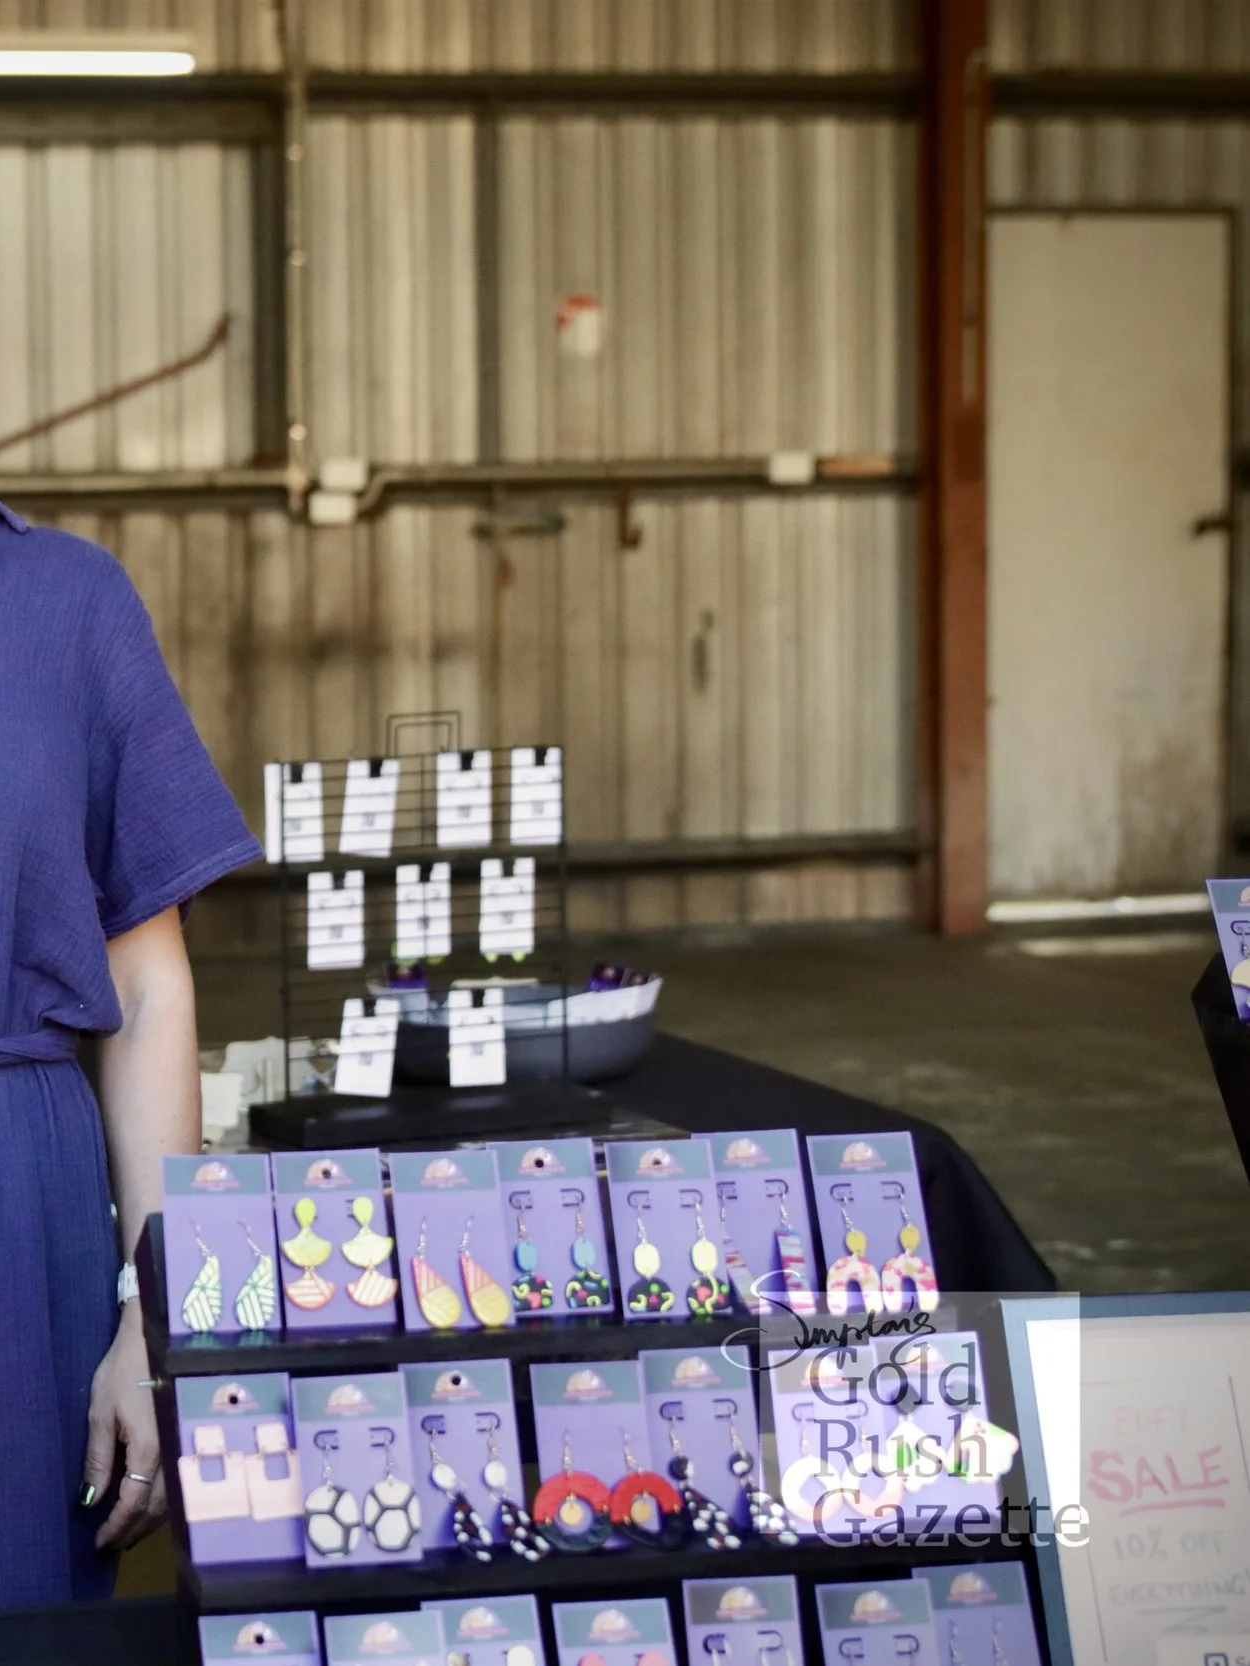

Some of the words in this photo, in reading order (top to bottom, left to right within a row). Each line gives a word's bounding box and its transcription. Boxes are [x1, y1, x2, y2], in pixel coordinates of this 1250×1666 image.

[1087, 1445, 1230, 1502] SALE
[1113, 1526, 1168, 1562] 10%
[1181, 1530, 1225, 1553] OFF
